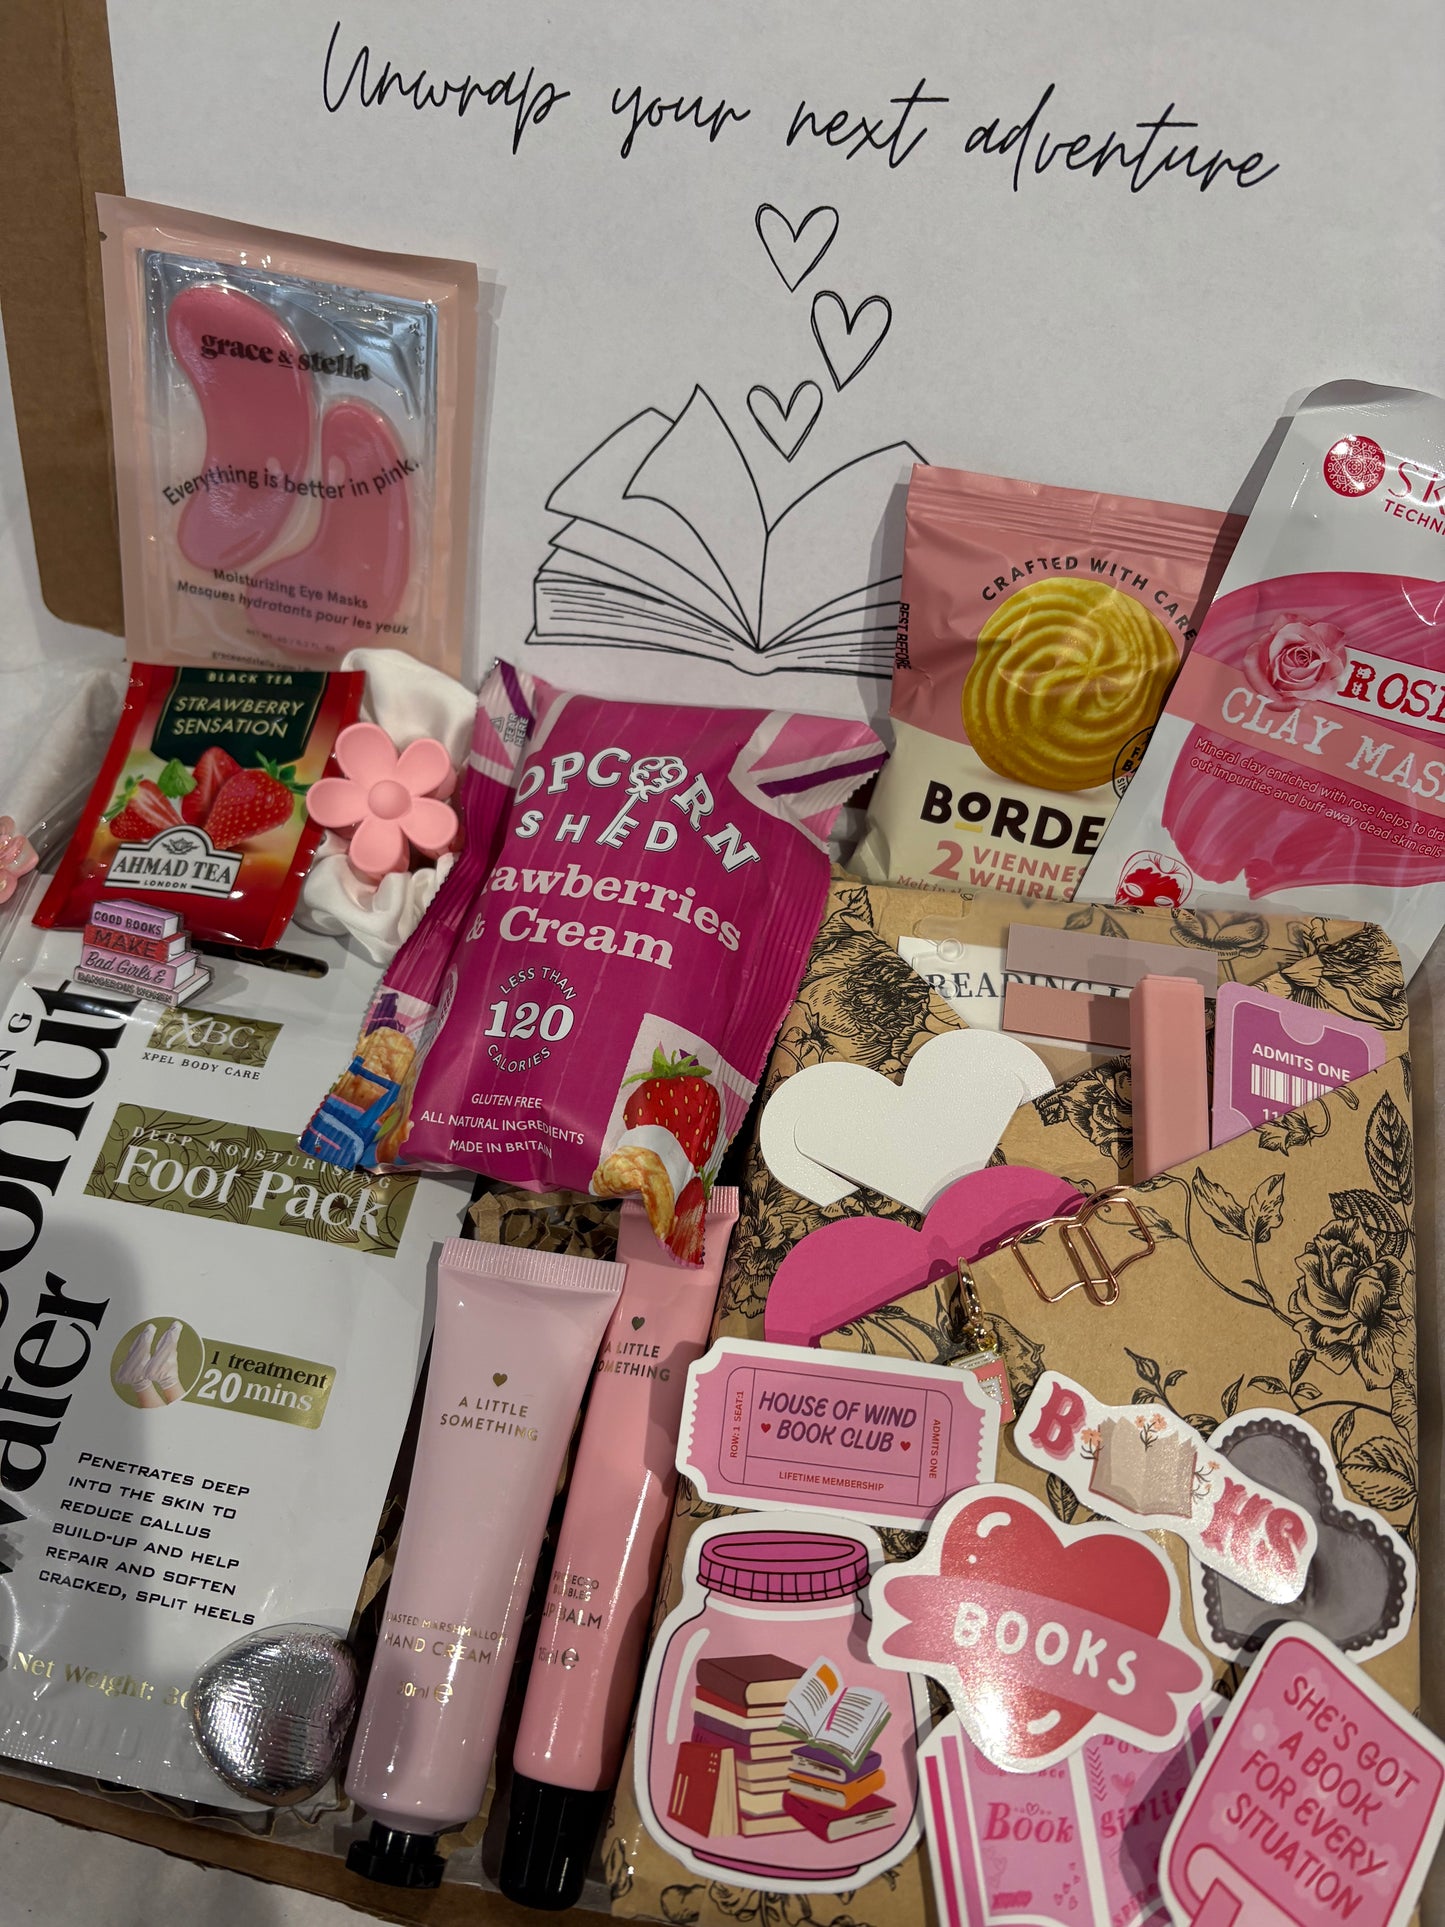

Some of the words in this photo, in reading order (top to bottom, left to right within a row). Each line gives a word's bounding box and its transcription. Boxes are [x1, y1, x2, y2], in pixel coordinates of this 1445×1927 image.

[323, 21, 571, 154] Unwrap
[612, 85, 751, 158] your
[786, 79, 949, 168] next
[965, 84, 1279, 192] adventure
[200, 333, 274, 363] grace
[278, 350, 294, 369] &
[297, 349, 371, 381] stella
[162, 464, 259, 506] Everything
[264, 468, 278, 489] is
[284, 474, 345, 499] better
[350, 479, 370, 497] in
[372, 458, 420, 495] pink.
[213, 568, 296, 598] Moisturizing
[299, 585, 323, 601] Eye
[327, 590, 369, 609] Masks
[981, 556, 1079, 602] CRAFTED
[1090, 557, 1149, 591] WITH
[1153, 589, 1198, 642] CARE
[177, 580, 235, 603] Masques
[315, 608, 350, 625] pour
[352, 615, 372, 630] les
[376, 620, 409, 635] yeux
[208, 671, 258, 685] BLACK
[266, 674, 293, 685] TEA
[174, 696, 304, 716] STRAWBERRY
[172, 717, 289, 739] SENSATION
[504, 712, 518, 743] TEAR
[514, 717, 529, 747] HERE
[1221, 686, 1344, 756] CLAY
[1345, 735, 1445, 803] MAS
[1190, 757, 1213, 773] out
[1213, 763, 1272, 796] impurities
[1273, 787, 1299, 804] and
[1298, 795, 1326, 815] buff
[1325, 808, 1358, 828] away
[1358, 817, 1391, 840] dead
[1392, 831, 1418, 851] skin
[1417, 842, 1442, 859] cells
[1194, 737, 1244, 766] Mineral
[1240, 757, 1267, 776] clay
[1266, 766, 1320, 794] enriched
[1320, 786, 1347, 804] with
[1348, 798, 1376, 816] rose
[1376, 806, 1411, 831] helps
[1412, 821, 1426, 835] to
[1427, 826, 1445, 842] dra
[515, 808, 678, 852] SHED
[112, 855, 189, 877] AHMAD
[193, 860, 231, 885] TEA
[928, 839, 964, 881] 2
[143, 879, 188, 889] LONDON
[896, 875, 929, 891] Melt
[93, 929, 160, 959] MAKE
[125, 917, 163, 936] BOOKS
[465, 912, 486, 943] &
[498, 905, 673, 970] Cream
[85, 951, 117, 971] Bad
[117, 959, 153, 981] Girls
[500, 967, 536, 995] LESS
[541, 966, 577, 1000] THAN
[77, 971, 136, 996] DANGEROUS
[136, 986, 174, 1004] WOMEN
[165, 1013, 256, 1049] XBC
[484, 1000, 575, 1042] 120
[142, 1051, 175, 1064] XPEL
[181, 1058, 220, 1073] BODY
[224, 1066, 261, 1081] CARE
[487, 1044, 551, 1073] CALORIES
[1252, 1043, 1314, 1072] ADMITS
[1317, 1062, 1351, 1082] ONE
[471, 1093, 513, 1107] GLUTEN
[514, 1096, 543, 1109] FREE
[420, 1110, 445, 1124] ALL
[448, 1114, 499, 1131] NATURAL
[502, 1119, 585, 1145] INGREDIENTS
[132, 1125, 194, 1147] DEEP
[206, 1141, 392, 1189] MOISTURISING
[449, 1139, 483, 1153] MADE
[486, 1142, 501, 1153] IN
[506, 1140, 552, 1159] BRITAIN
[114, 1144, 242, 1204] Foot
[248, 1169, 387, 1237] Pack
[604, 1340, 612, 1353] A
[615, 1341, 661, 1358] LITTLE
[228, 1353, 328, 1389] treatment
[595, 1361, 671, 1382] OMETHING
[197, 1368, 243, 1404] 20
[243, 1382, 314, 1412] mins
[458, 1396, 468, 1407] A
[476, 1398, 529, 1418] LITTLE
[440, 1413, 539, 1441] SOMETHING
[758, 1390, 829, 1418] HOUSE
[832, 1399, 861, 1421] OF
[864, 1403, 917, 1429] WIND
[776, 1418, 837, 1446] BOOK
[840, 1427, 894, 1453] CLUB
[930, 1419, 941, 1456] ADMITS
[778, 1470, 821, 1484] LIFETIME
[822, 1476, 885, 1491] MEMBERSHIP
[928, 1457, 938, 1479] ONE
[68, 1475, 112, 1494] INTO
[119, 1485, 156, 1503] THE
[161, 1495, 205, 1513] SKIN
[212, 1504, 237, 1520] TO
[201, 1478, 251, 1497] DEEP
[60, 1498, 134, 1523] REDUCE
[140, 1515, 211, 1540] CALLUS
[52, 1522, 138, 1548] BUILD-UP
[143, 1542, 184, 1559] AND
[190, 1551, 240, 1570] HELP
[46, 1546, 109, 1569] REPAIR
[115, 1561, 156, 1578] AND
[162, 1571, 236, 1596] SOFTEN
[38, 1569, 127, 1601] CRACKED,
[135, 1590, 188, 1610] SPLIT
[193, 1603, 256, 1626] HEELS
[559, 1607, 603, 1630] BALM
[385, 1631, 426, 1653] HAND
[432, 1640, 492, 1665] CREAM
[953, 1601, 1137, 1696] BOOKS
[12, 1650, 56, 1678] Net
[64, 1663, 155, 1701] Weight:
[1283, 1675, 1359, 1752] SHE'S
[1356, 1741, 1421, 1798] GOT
[1278, 1730, 1304, 1761] A
[1300, 1746, 1384, 1827] BOOK
[982, 1802, 1075, 1843] Book
[1240, 1749, 1297, 1810] FOR
[1293, 1797, 1389, 1877] EVERY
[1226, 1792, 1364, 1921] SITUATION
